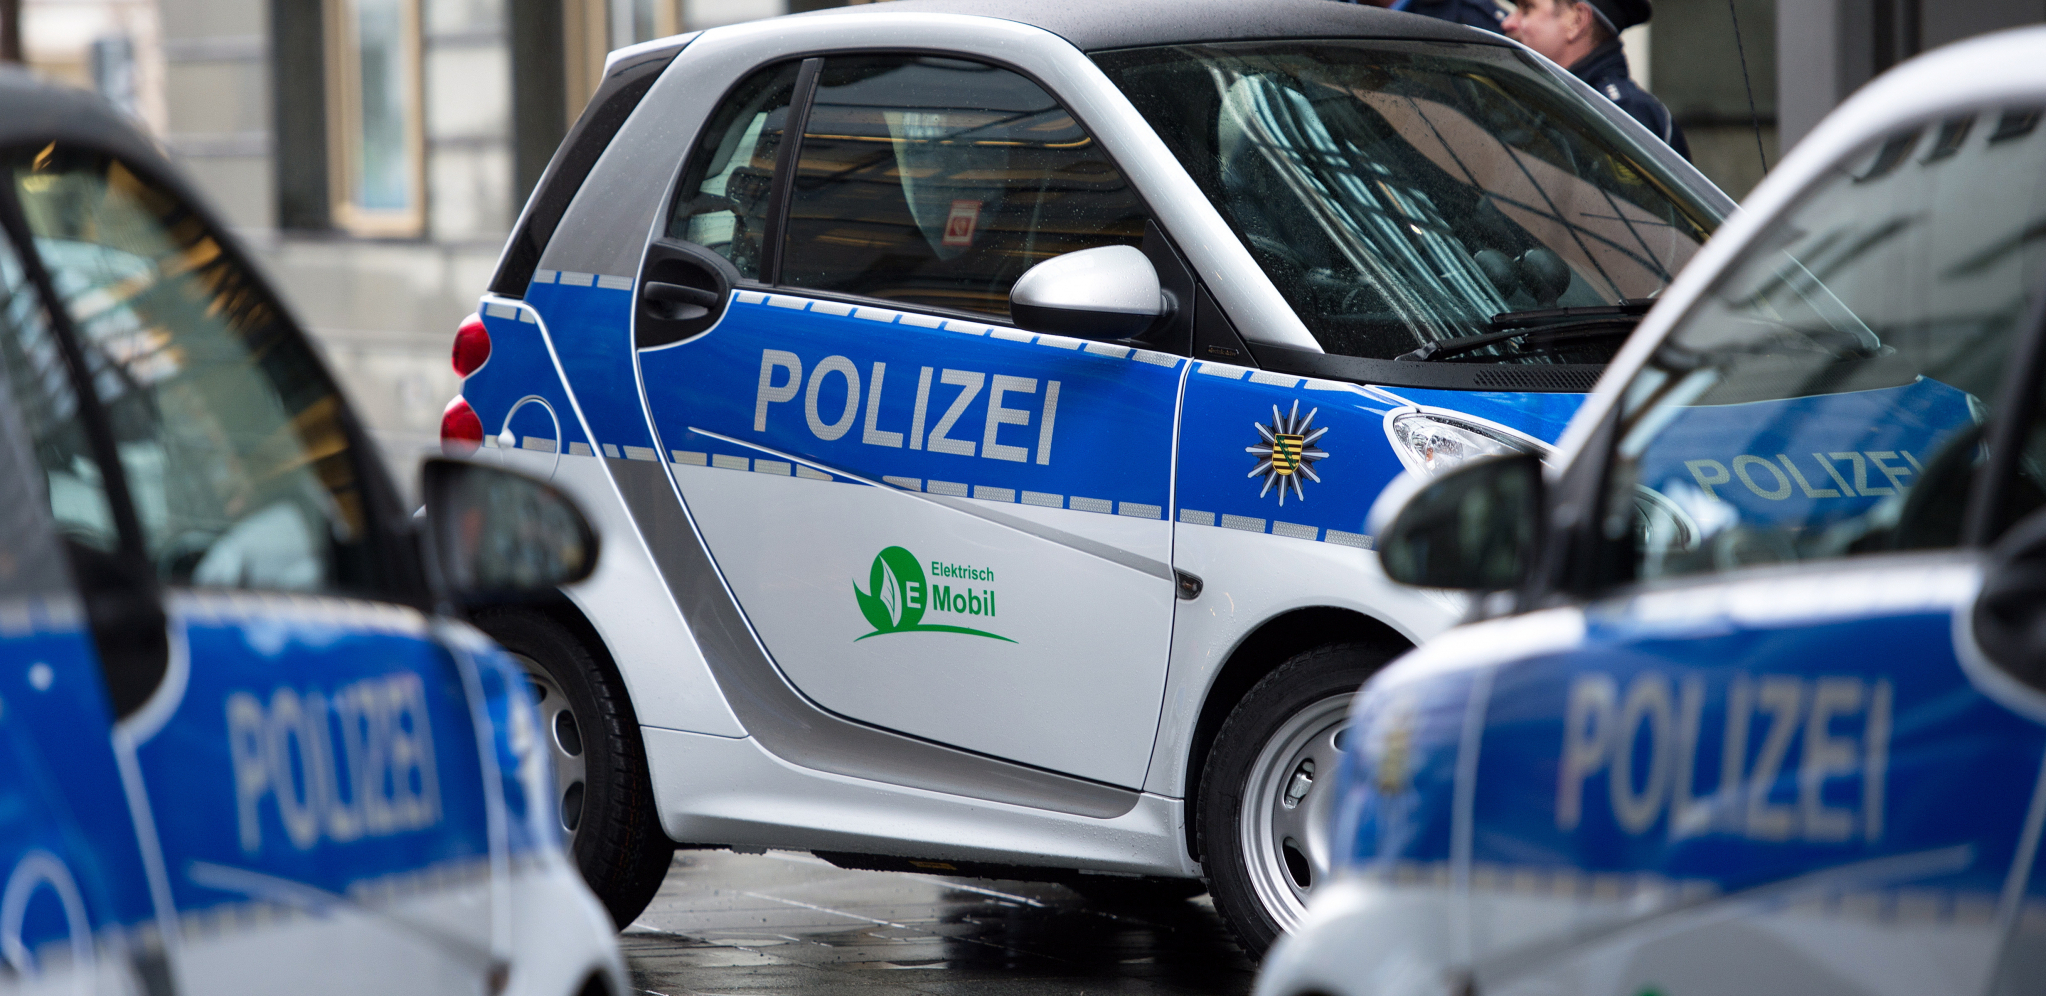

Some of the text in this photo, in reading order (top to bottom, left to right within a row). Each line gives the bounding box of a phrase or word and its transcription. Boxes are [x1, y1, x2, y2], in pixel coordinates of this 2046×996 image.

[754, 349, 1061, 465] POLIZEI
[906, 581, 995, 617] E Mobil
[931, 561, 994, 582] Elektrisch
[228, 673, 441, 853] POLIZEI
[1556, 673, 1891, 842] POLIZEI
